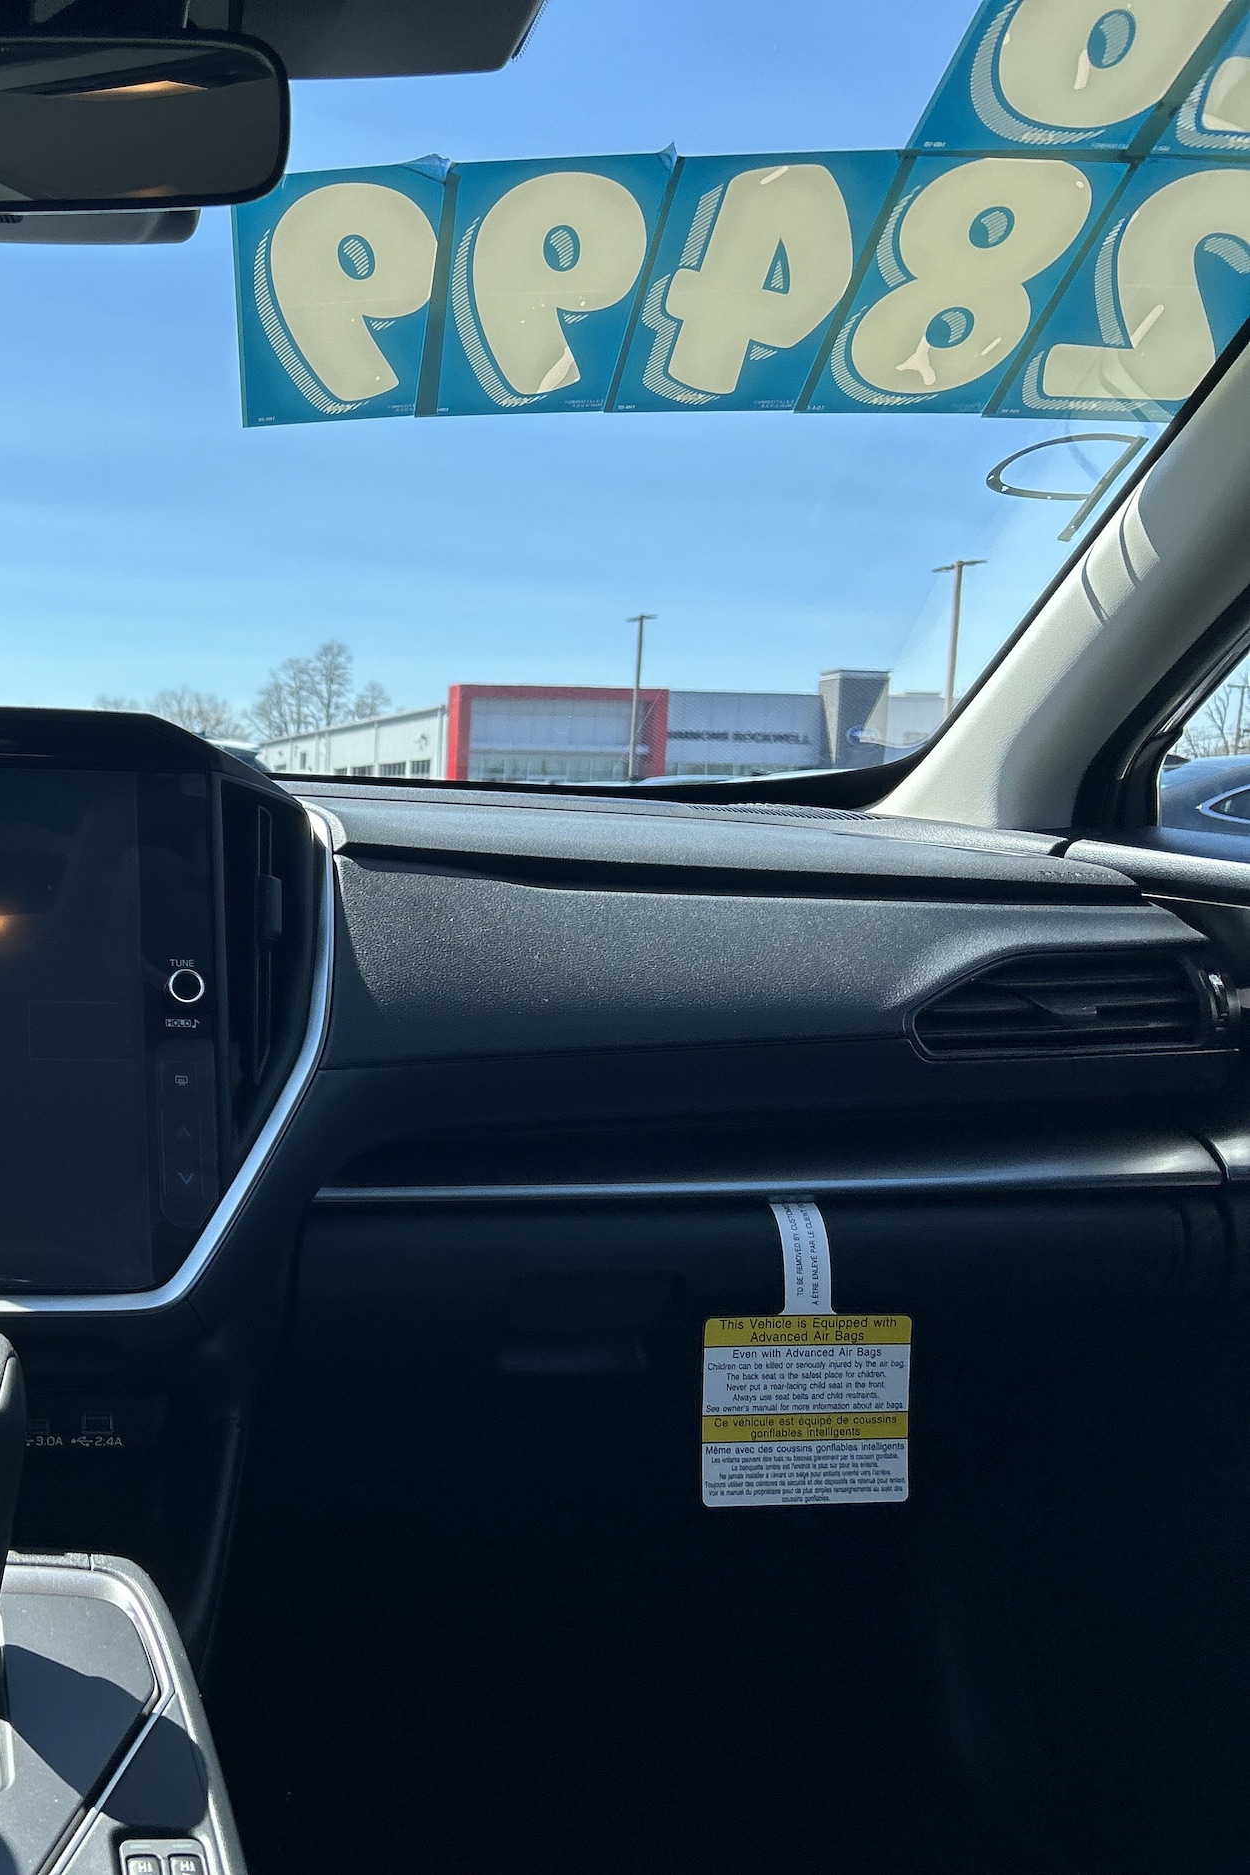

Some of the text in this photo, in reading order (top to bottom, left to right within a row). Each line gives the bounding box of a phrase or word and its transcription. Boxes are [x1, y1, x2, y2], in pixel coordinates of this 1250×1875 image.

[169, 958, 195, 967] TUNE
[165, 1018, 192, 1027] HOLD
[719, 1317, 896, 1329] This Vehicle is Equipped with
[750, 1330, 864, 1343] Advanced Air Bags
[732, 1347, 881, 1358] Even with Advanced Air Bags
[707, 1362, 735, 1370] Children
[765, 1361, 783, 1369] killed
[854, 1360, 862, 1368] by
[726, 1372, 739, 1380] The
[742, 1372, 759, 1380] back
[787, 1371, 798, 1379] the
[824, 1370, 842, 1379] place
[725, 1383, 747, 1391] Never
[809, 1381, 825, 1389] child
[779, 1402, 789, 1410] for
[714, 1417, 728, 1427] Ce
[732, 1416, 773, 1426] véhicule
[779, 1416, 793, 1426] est
[836, 1415, 848, 1424] de
[853, 1416, 896, 1424] coussins
[750, 1427, 860, 1440] gonflables intelligents
[36, 1436, 123, 1446] 3.0A 2.4A
[705, 1445, 731, 1454] Même
[735, 1446, 754, 1454] avec
[757, 1444, 773, 1453] des
[815, 1442, 857, 1453] gonflables
[861, 1442, 904, 1452] intelligents
